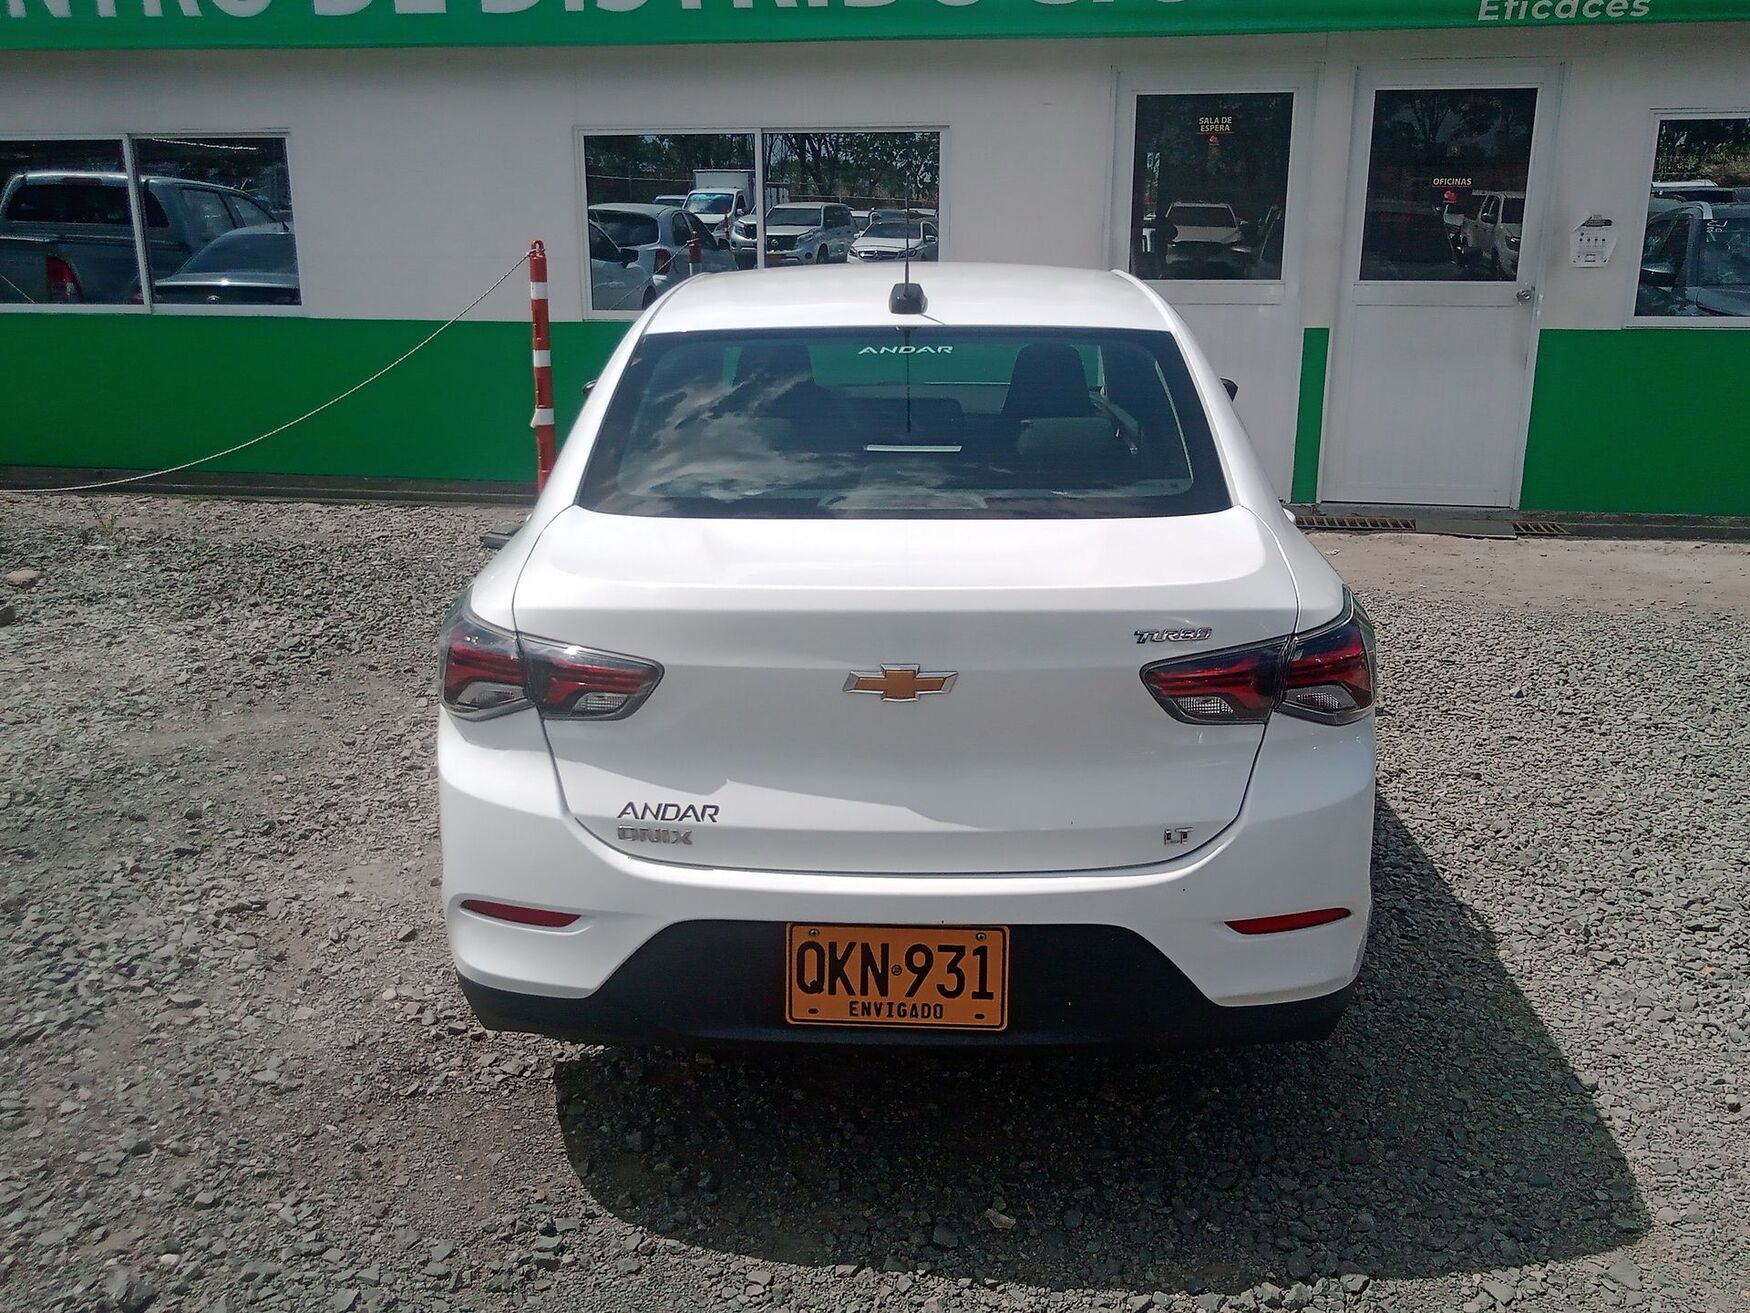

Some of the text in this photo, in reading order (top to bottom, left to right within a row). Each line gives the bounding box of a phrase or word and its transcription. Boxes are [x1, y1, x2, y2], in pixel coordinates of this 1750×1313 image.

[1200, 124, 1230, 132] ESPERA
[1432, 177, 1472, 186] OFICINAS
[858, 346, 953, 354] ANDAR
[1134, 628, 1212, 644] TURBO
[617, 801, 720, 823] ANDAR
[617, 825, 693, 845] ONIX
[1164, 826, 1194, 845] LT
[849, 1001, 944, 1019] ENVIGADO
